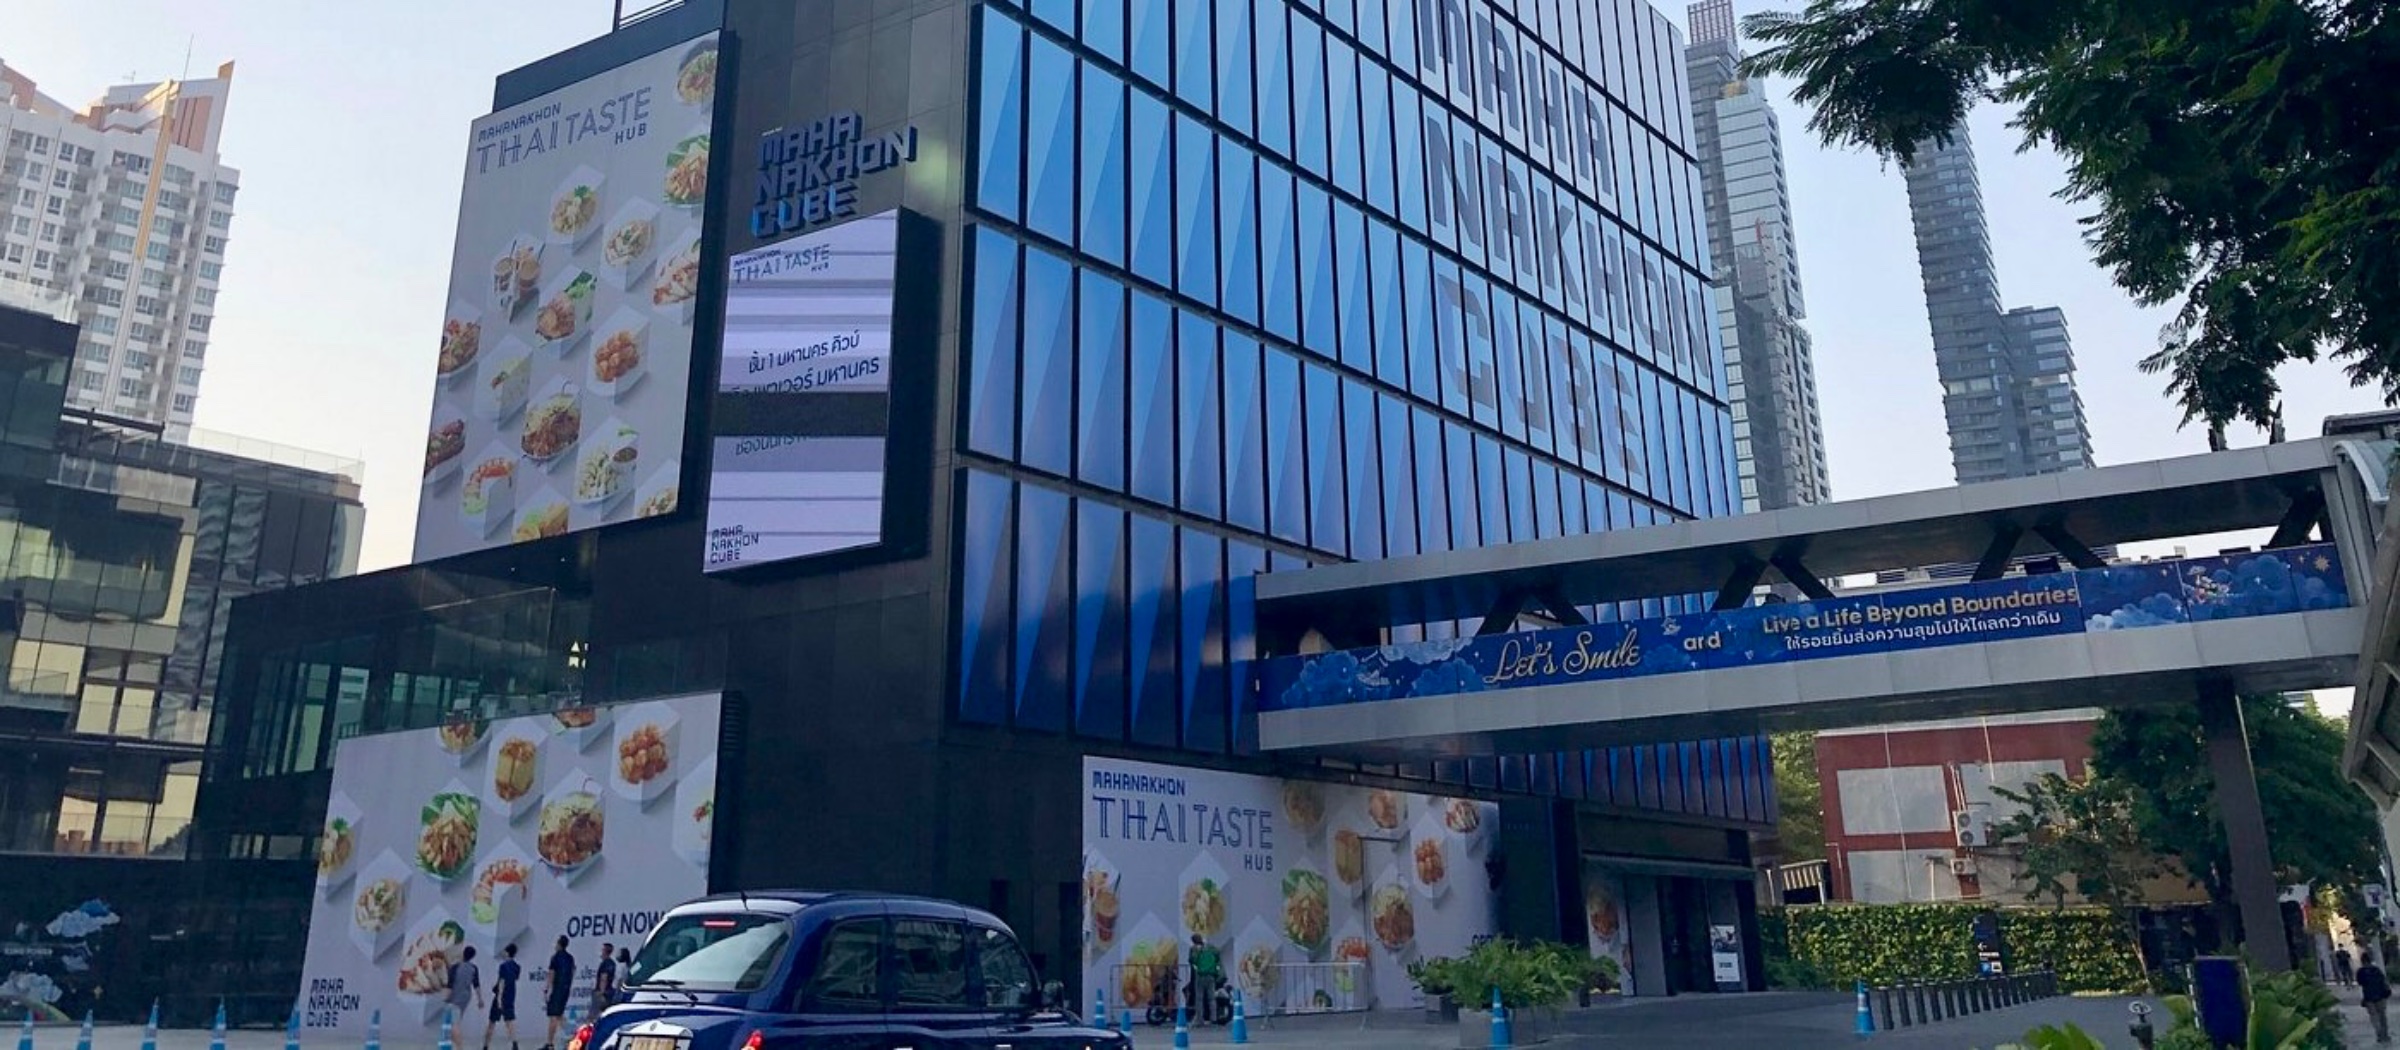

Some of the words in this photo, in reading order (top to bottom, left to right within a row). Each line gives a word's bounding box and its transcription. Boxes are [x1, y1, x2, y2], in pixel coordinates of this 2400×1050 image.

[1420, 0, 1611, 196] MAHA
[477, 121, 559, 174] THAI
[566, 87, 652, 144] TASTE
[478, 102, 561, 142] MAHANAKHON
[615, 123, 647, 145] HUB
[758, 110, 863, 170] MAHA
[755, 123, 918, 206] NAKHON
[753, 181, 859, 239] CUBE
[734, 256, 782, 284] THAI
[785, 243, 830, 271] TASTE
[1427, 114, 1710, 379] NAKHON
[768, 353, 774, 369] 1
[778, 342, 829, 367] มหานคร
[817, 356, 880, 386] มหานคร
[1438, 271, 1644, 477] CUBE
[711, 532, 759, 552] NAKHON
[712, 525, 743, 539] MAHA
[710, 548, 741, 564] CUBE
[1482, 639, 1558, 684] Let's
[1563, 627, 1641, 676] Smile
[1763, 616, 1801, 634] Live
[1806, 616, 1820, 629] a
[1823, 608, 1862, 627] Life
[1866, 598, 1947, 625] Beyond
[1951, 586, 2078, 614] Boundaries
[1093, 771, 1185, 796] MAHANAKHON
[1093, 795, 1188, 843] THAI
[1193, 804, 1273, 850] TASTE
[1244, 854, 1273, 871] HUB
[567, 913, 616, 938] OPEN
[309, 994, 360, 1011] NAKHON
